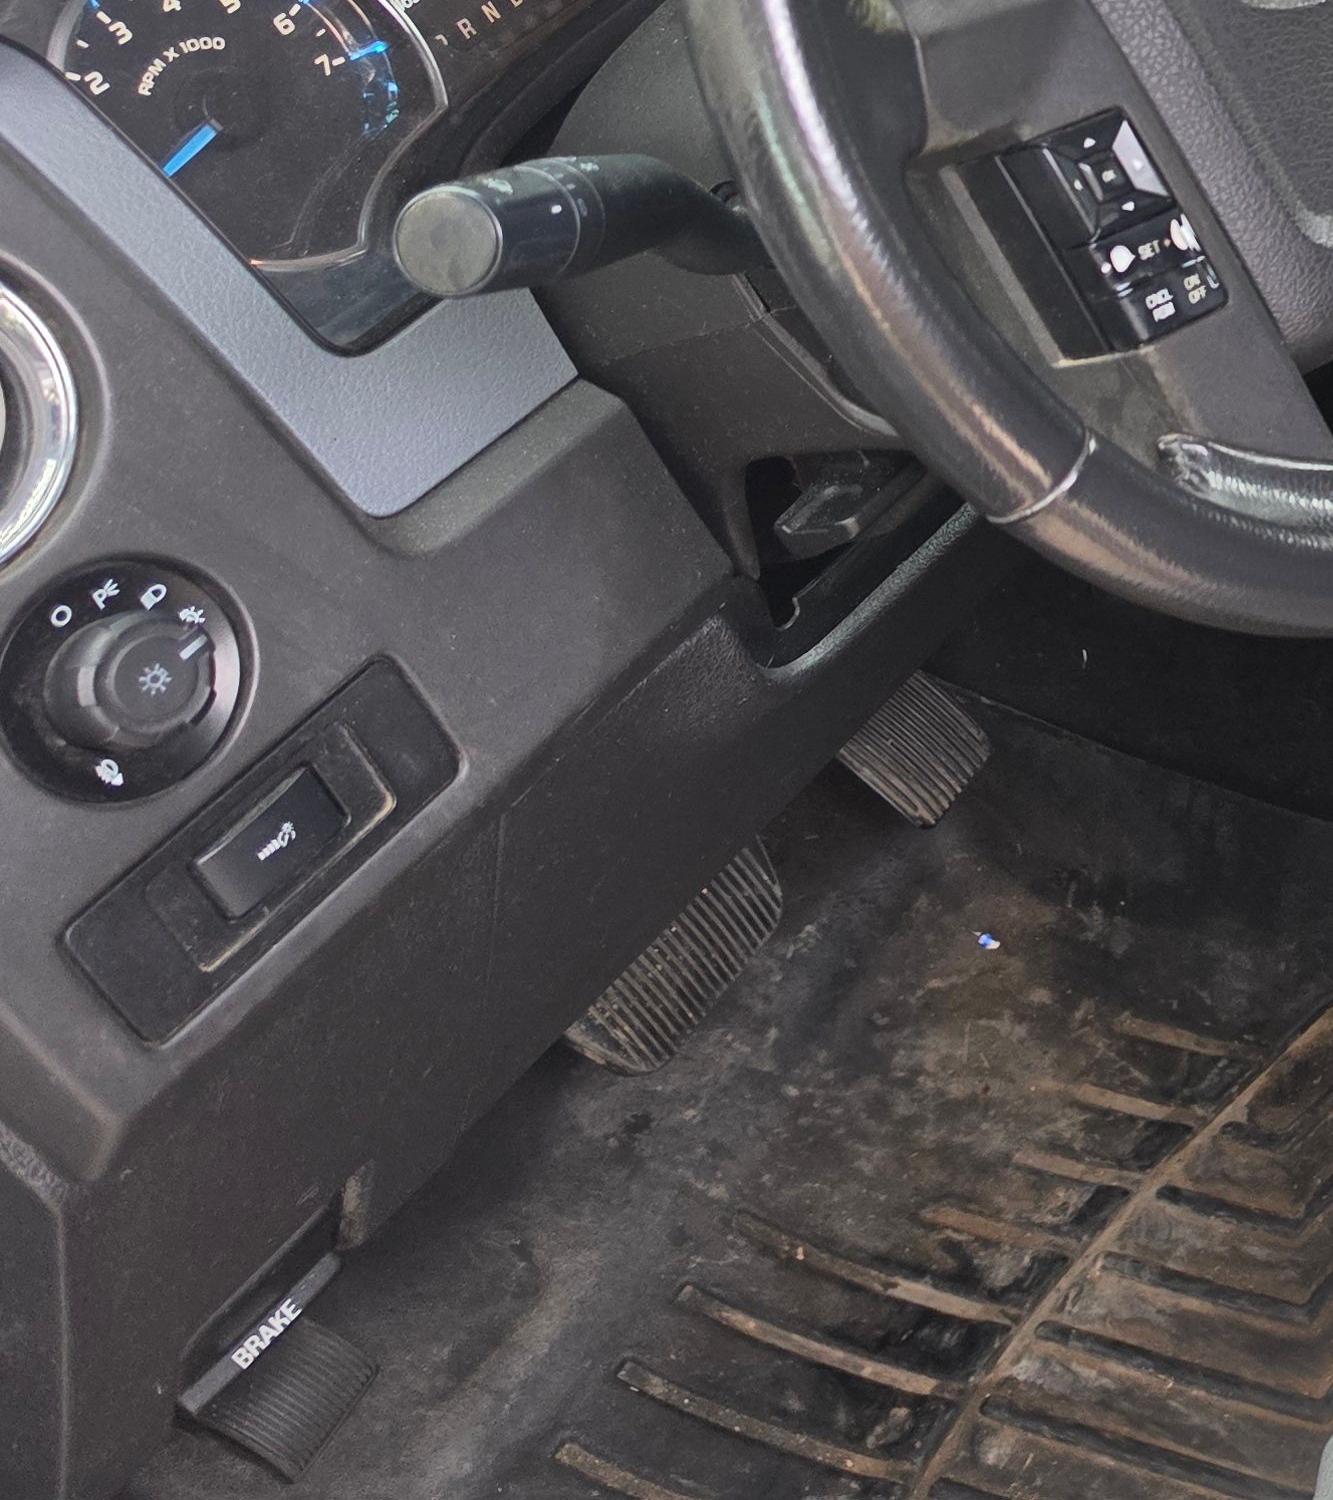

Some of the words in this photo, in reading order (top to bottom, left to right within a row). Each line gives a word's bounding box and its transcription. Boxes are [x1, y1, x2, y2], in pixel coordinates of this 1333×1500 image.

[272, 13, 296, 36] 6
[456, 17, 477, 40] R
[481, 0, 501, 23] N
[108, 21, 133, 45] 3
[138, 58, 167, 96] RPM
[179, 36, 226, 55] 1000
[314, 53, 331, 76] 7
[85, 71, 110, 95] 2
[1137, 239, 1161, 260] SET
[231, 1298, 303, 1370] BRAKE
